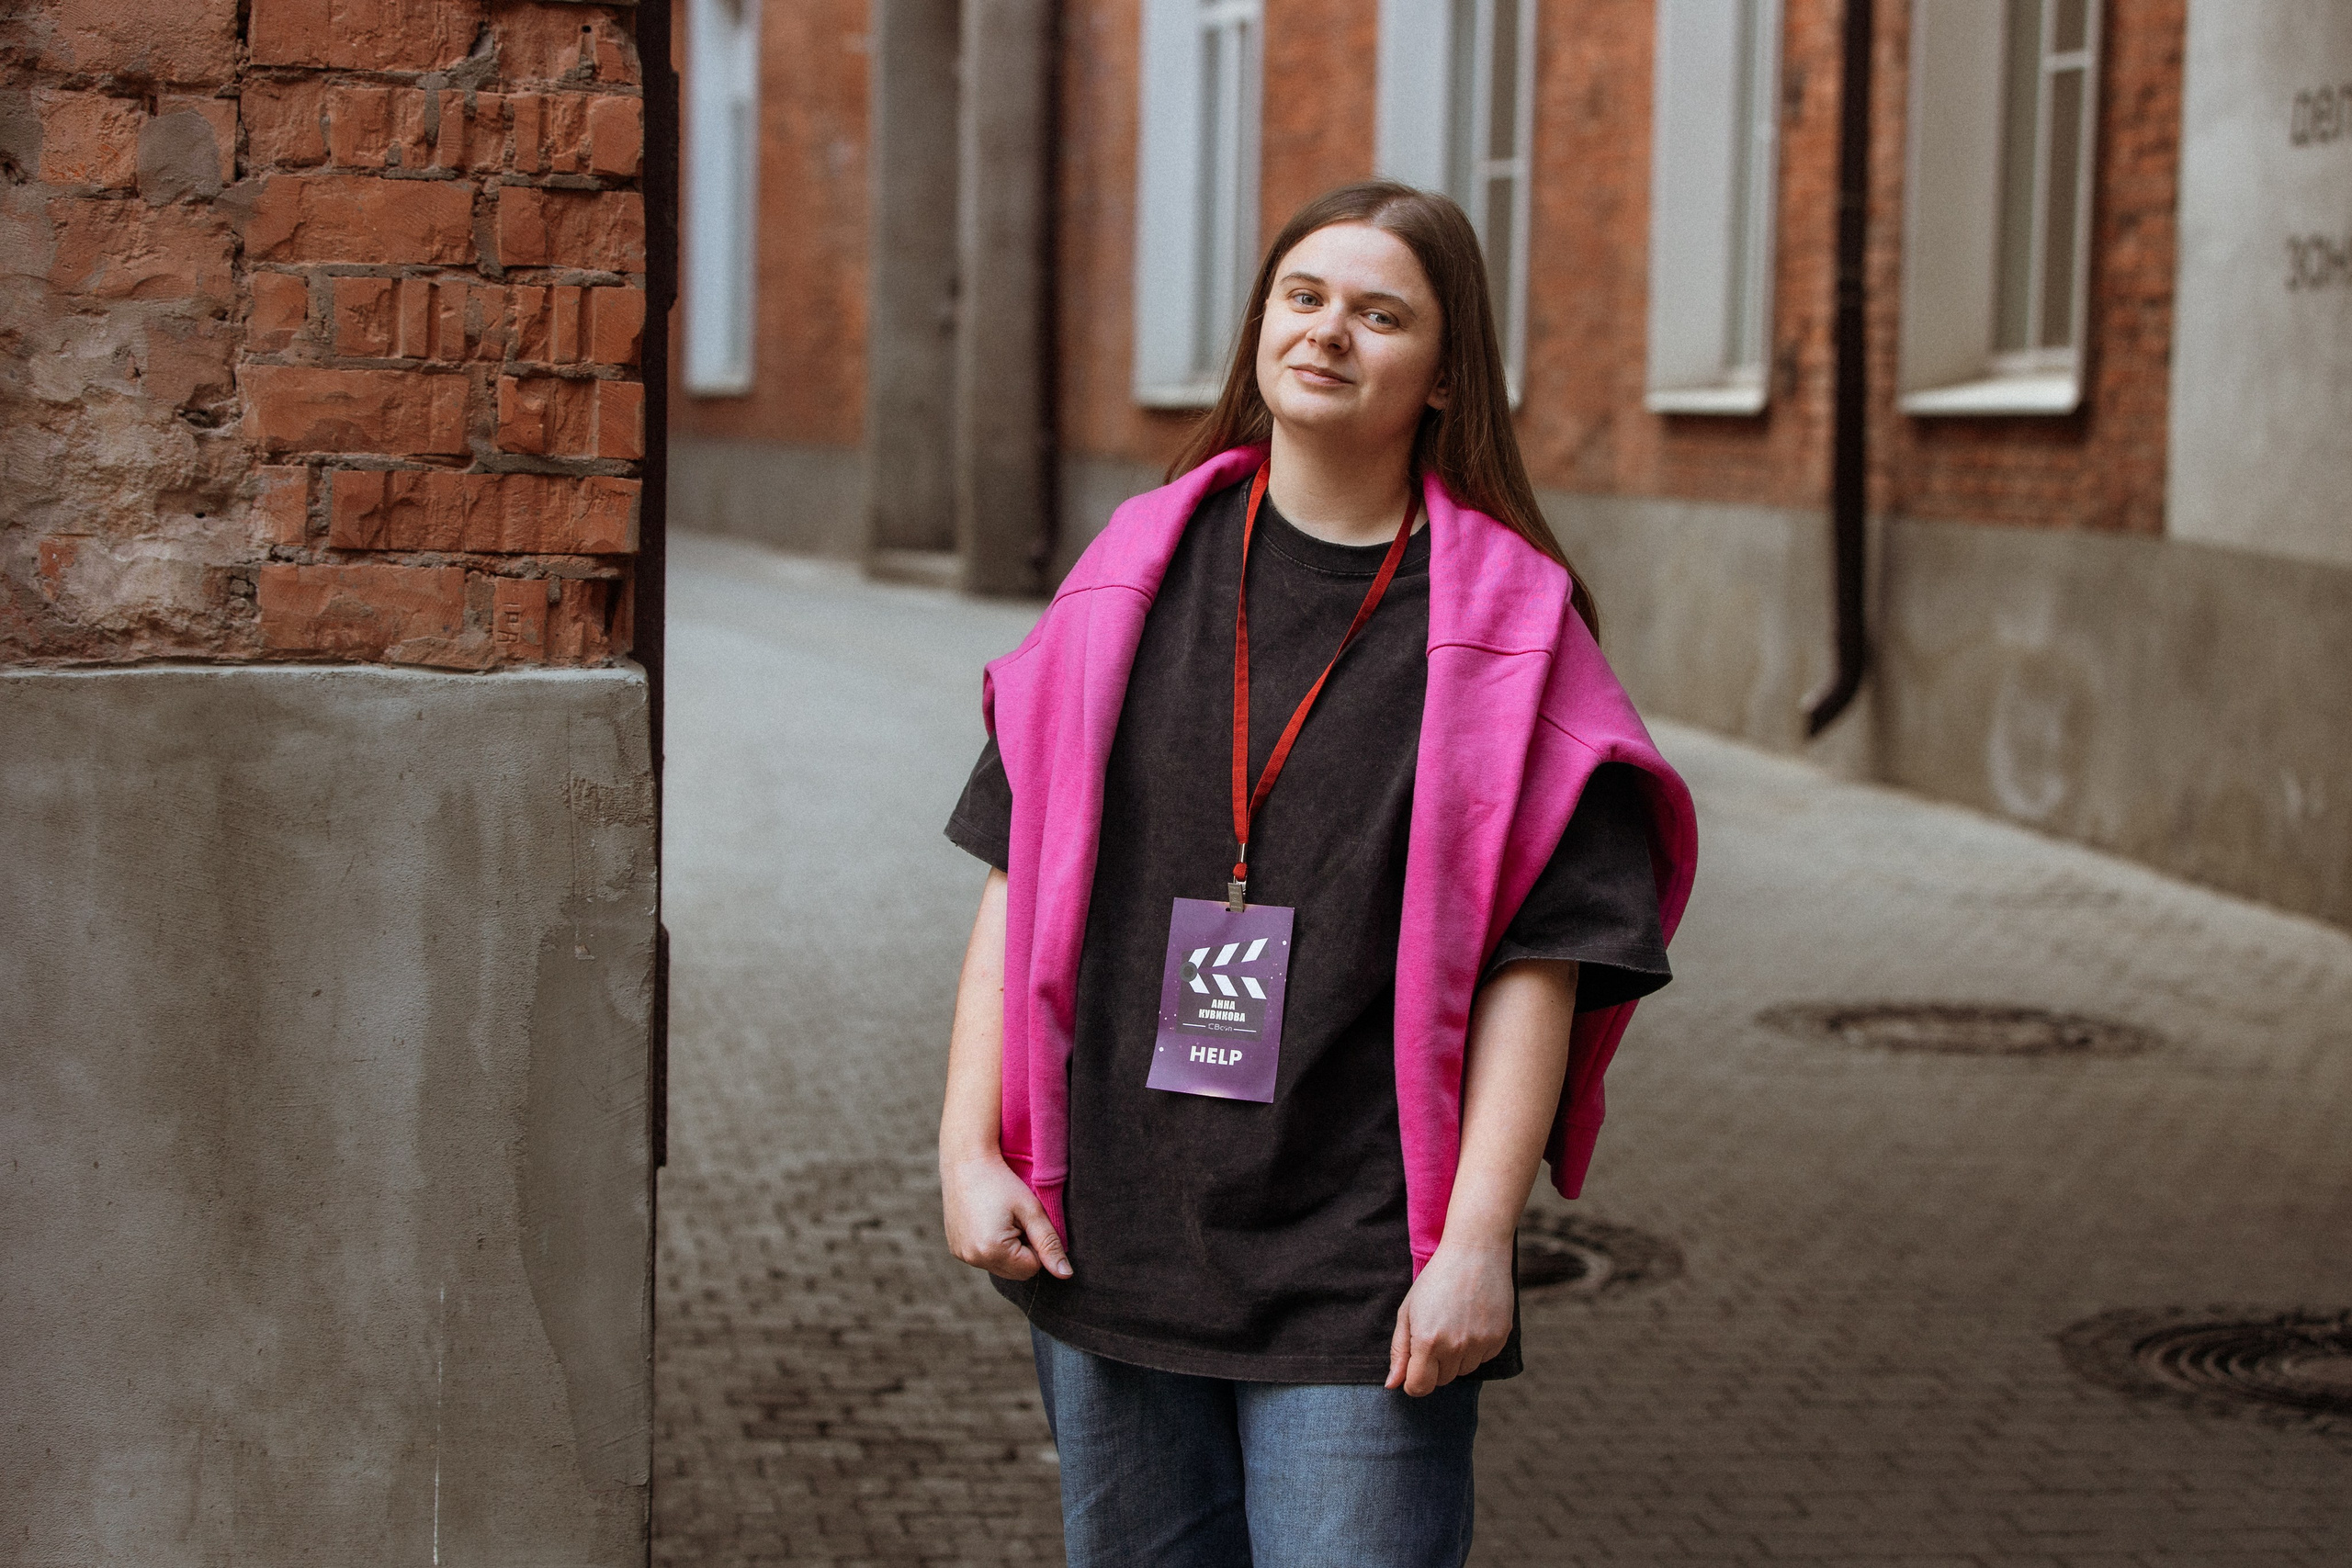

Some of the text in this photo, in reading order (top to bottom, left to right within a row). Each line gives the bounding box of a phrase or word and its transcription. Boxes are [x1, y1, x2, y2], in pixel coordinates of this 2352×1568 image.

[1211, 998, 1236, 1010] АННА
[1198, 1009, 1246, 1022] КУВИКОВА
[1189, 1045, 1244, 1066] HELP
